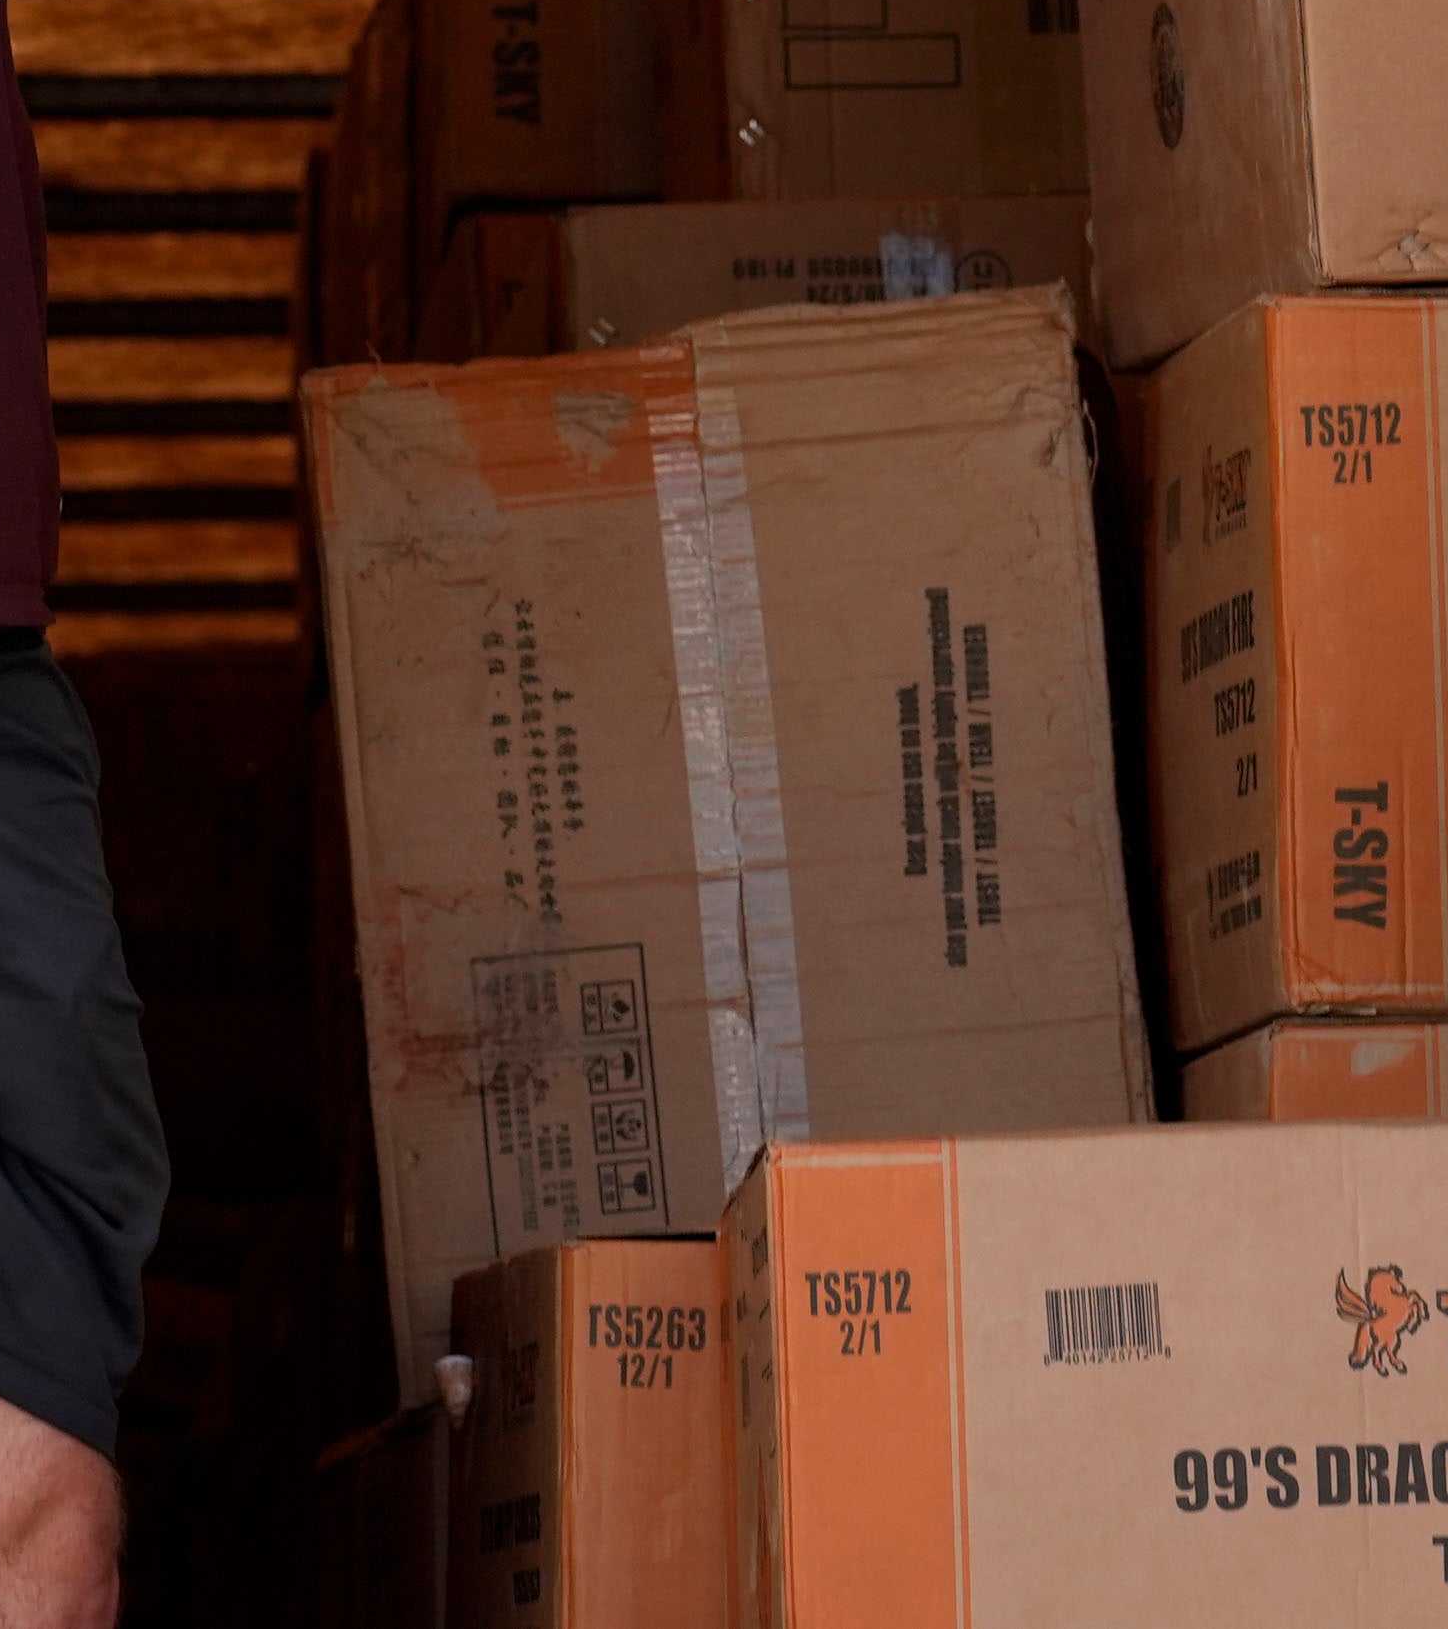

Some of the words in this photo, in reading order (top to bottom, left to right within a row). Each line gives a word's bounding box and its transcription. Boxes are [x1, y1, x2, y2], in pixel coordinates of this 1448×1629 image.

[1300, 402, 1401, 446] TS5712
[1334, 450, 1372, 483] 2/1
[1237, 753, 1257, 797] 2/1
[1334, 782, 1388, 929] T-SKY
[805, 1270, 911, 1316] TS5712
[589, 1306, 706, 1352] TS5263
[840, 1320, 880, 1355] 2/1
[618, 1353, 672, 1388] 12/1
[1174, 1446, 1299, 1512] 99'S
